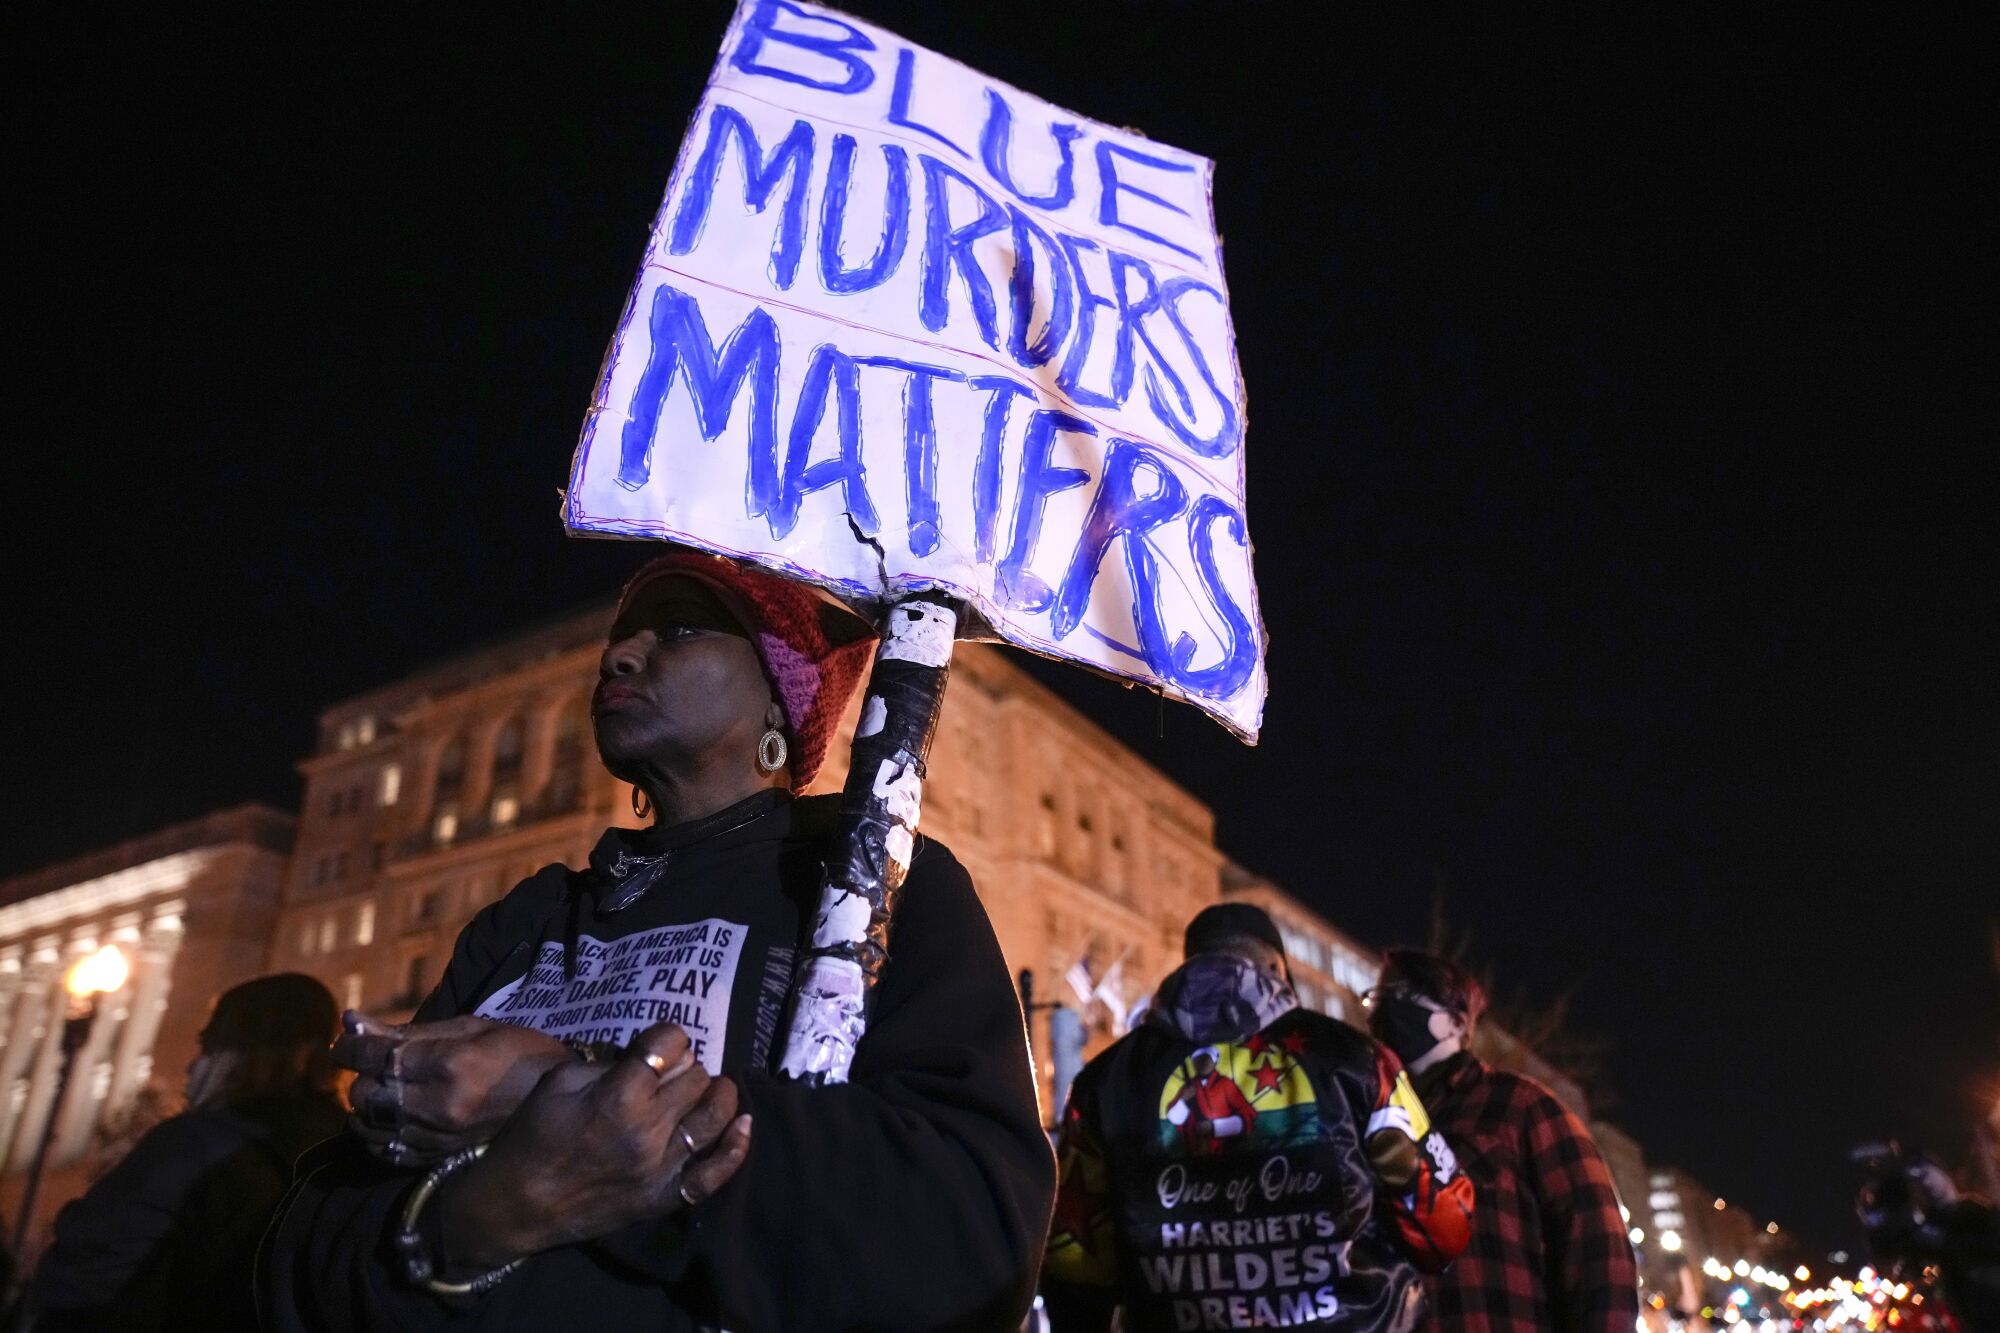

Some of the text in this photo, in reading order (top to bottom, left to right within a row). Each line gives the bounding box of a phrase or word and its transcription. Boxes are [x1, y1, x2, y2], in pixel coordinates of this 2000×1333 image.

[731, 0, 1205, 263] BLUE
[667, 104, 1237, 459] MURDERS
[614, 284, 1257, 699] MATTERS
[599, 953, 642, 977] Y'ALL
[645, 946, 697, 967] WANT
[698, 948, 724, 968] US
[612, 939, 633, 959] IN
[631, 925, 708, 952] AMERICA
[712, 927, 732, 947] IS
[566, 970, 642, 1003] DANCE,
[649, 969, 717, 999] PLAY
[541, 1005, 593, 1030] SHOOT
[591, 999, 709, 1034] BASKETBALL,
[1157, 1155, 1323, 1213] One of One
[1161, 1211, 1336, 1248] HARRIET'S
[1139, 1240, 1352, 1294] WILDEST
[1173, 1285, 1338, 1332] DREAMS
